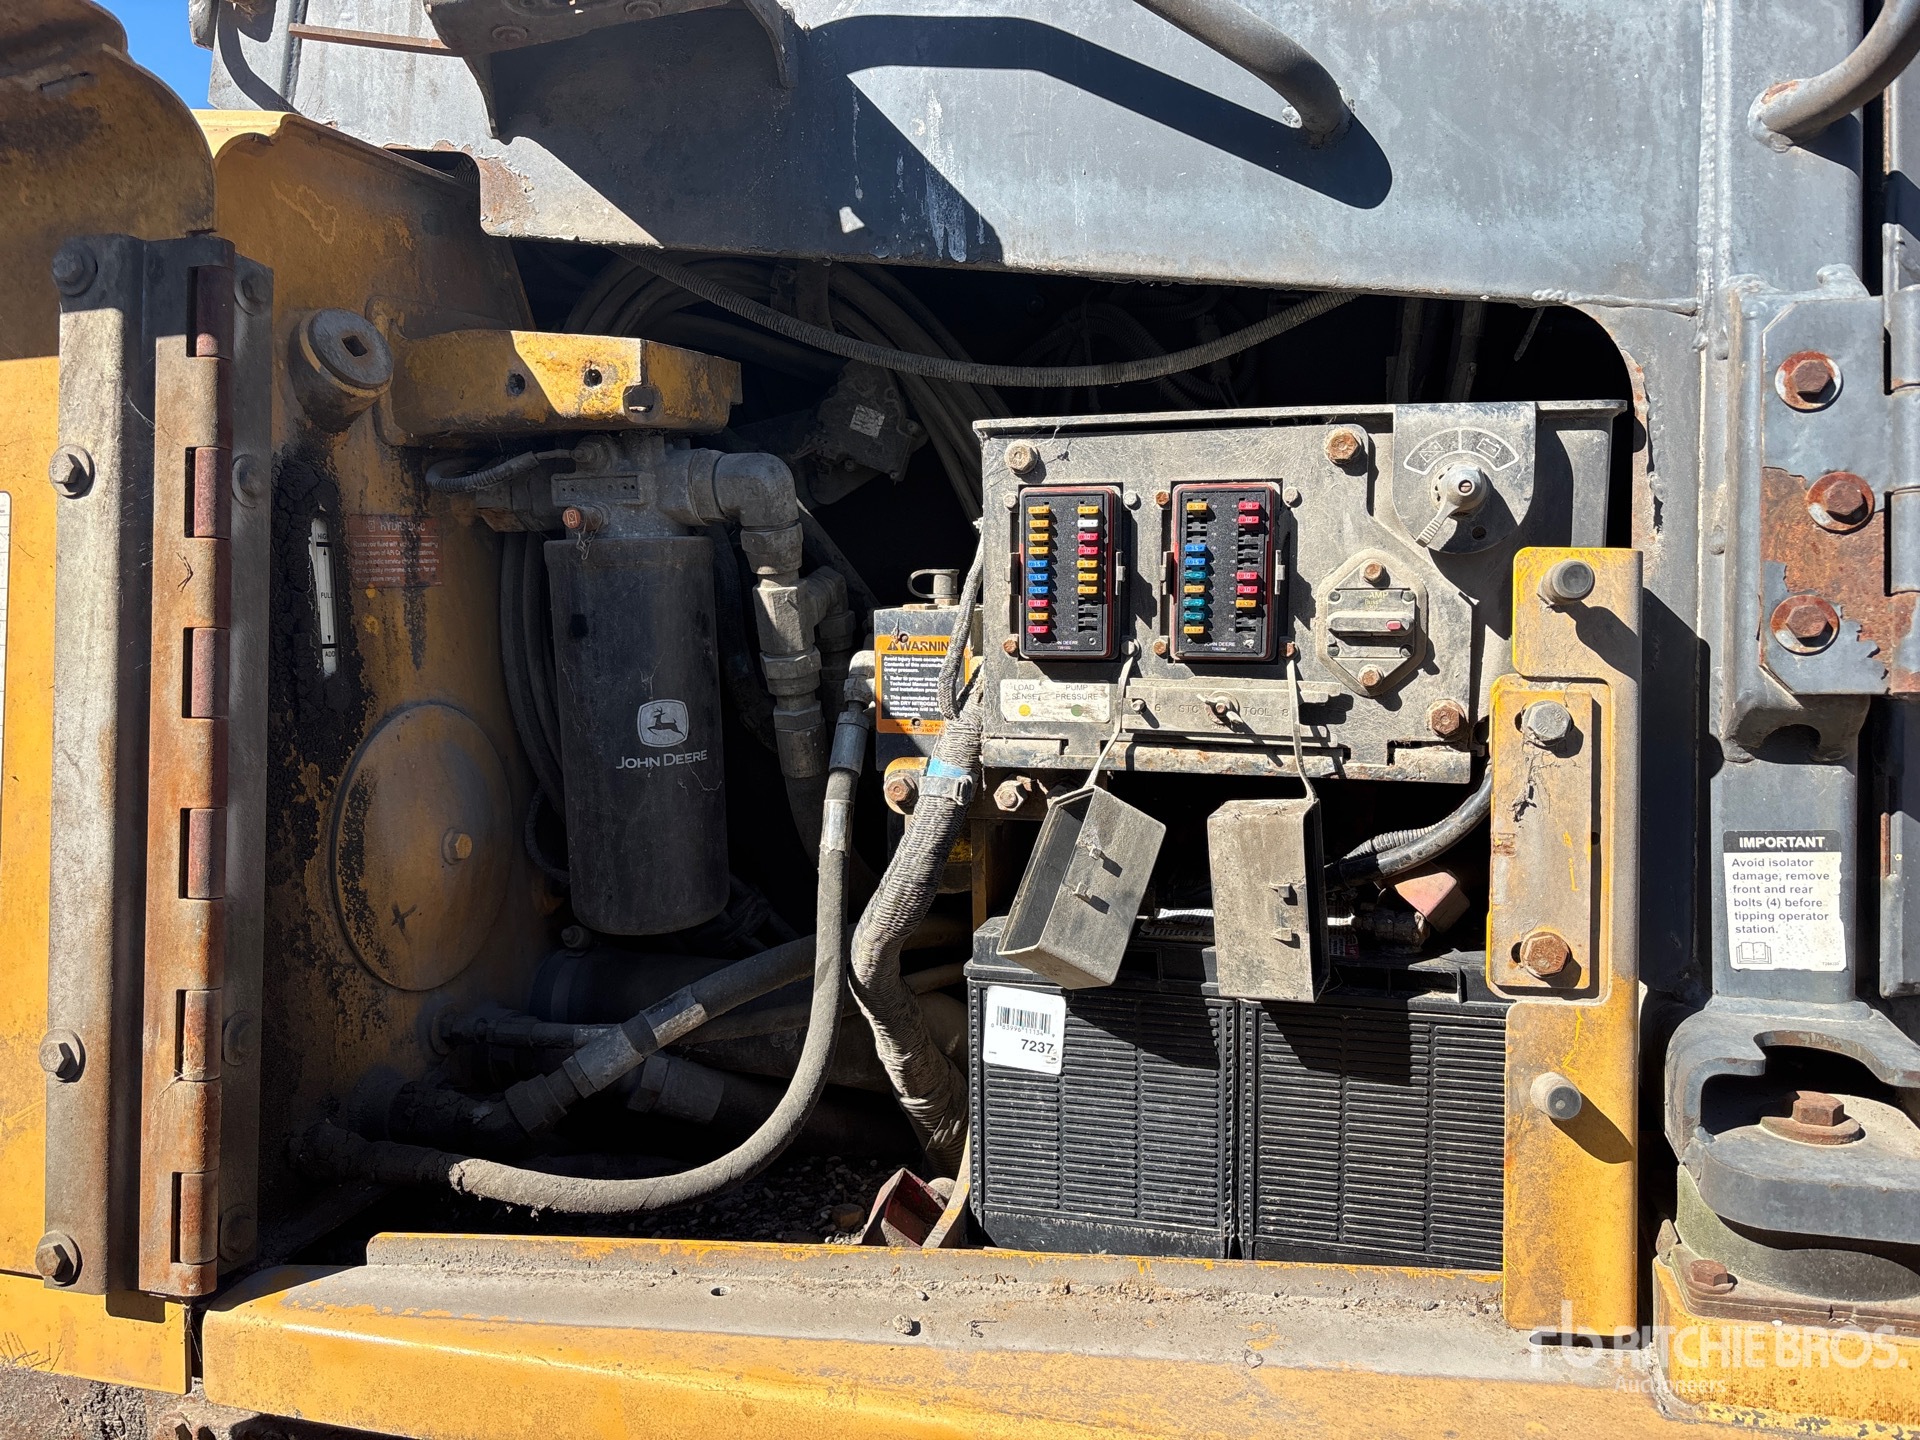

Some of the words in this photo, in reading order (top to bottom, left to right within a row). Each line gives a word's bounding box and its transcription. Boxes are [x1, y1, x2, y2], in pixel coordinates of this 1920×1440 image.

[900, 640, 949, 652] WARNIN
[1155, 703, 1161, 712] 6
[1243, 706, 1271, 717] TOOL
[1281, 709, 1289, 717] 8
[616, 756, 660, 770] JOHN
[664, 750, 708, 766] DEERE
[1739, 836, 1825, 848] IMPORTANT
[1732, 858, 1765, 867] Avoid
[1769, 858, 1814, 867] isolator
[1732, 872, 1782, 882] damage,
[1733, 885, 1760, 894] front
[1764, 885, 1786, 894] and
[1734, 898, 1762, 907] bolts
[1766, 898, 1781, 909] (4)
[1785, 898, 1823, 907] before
[1735, 912, 1775, 923] tipping
[1778, 913, 1829, 922] operator
[1736, 925, 1778, 934] station.
[1021, 1038, 1054, 1054] 7237
